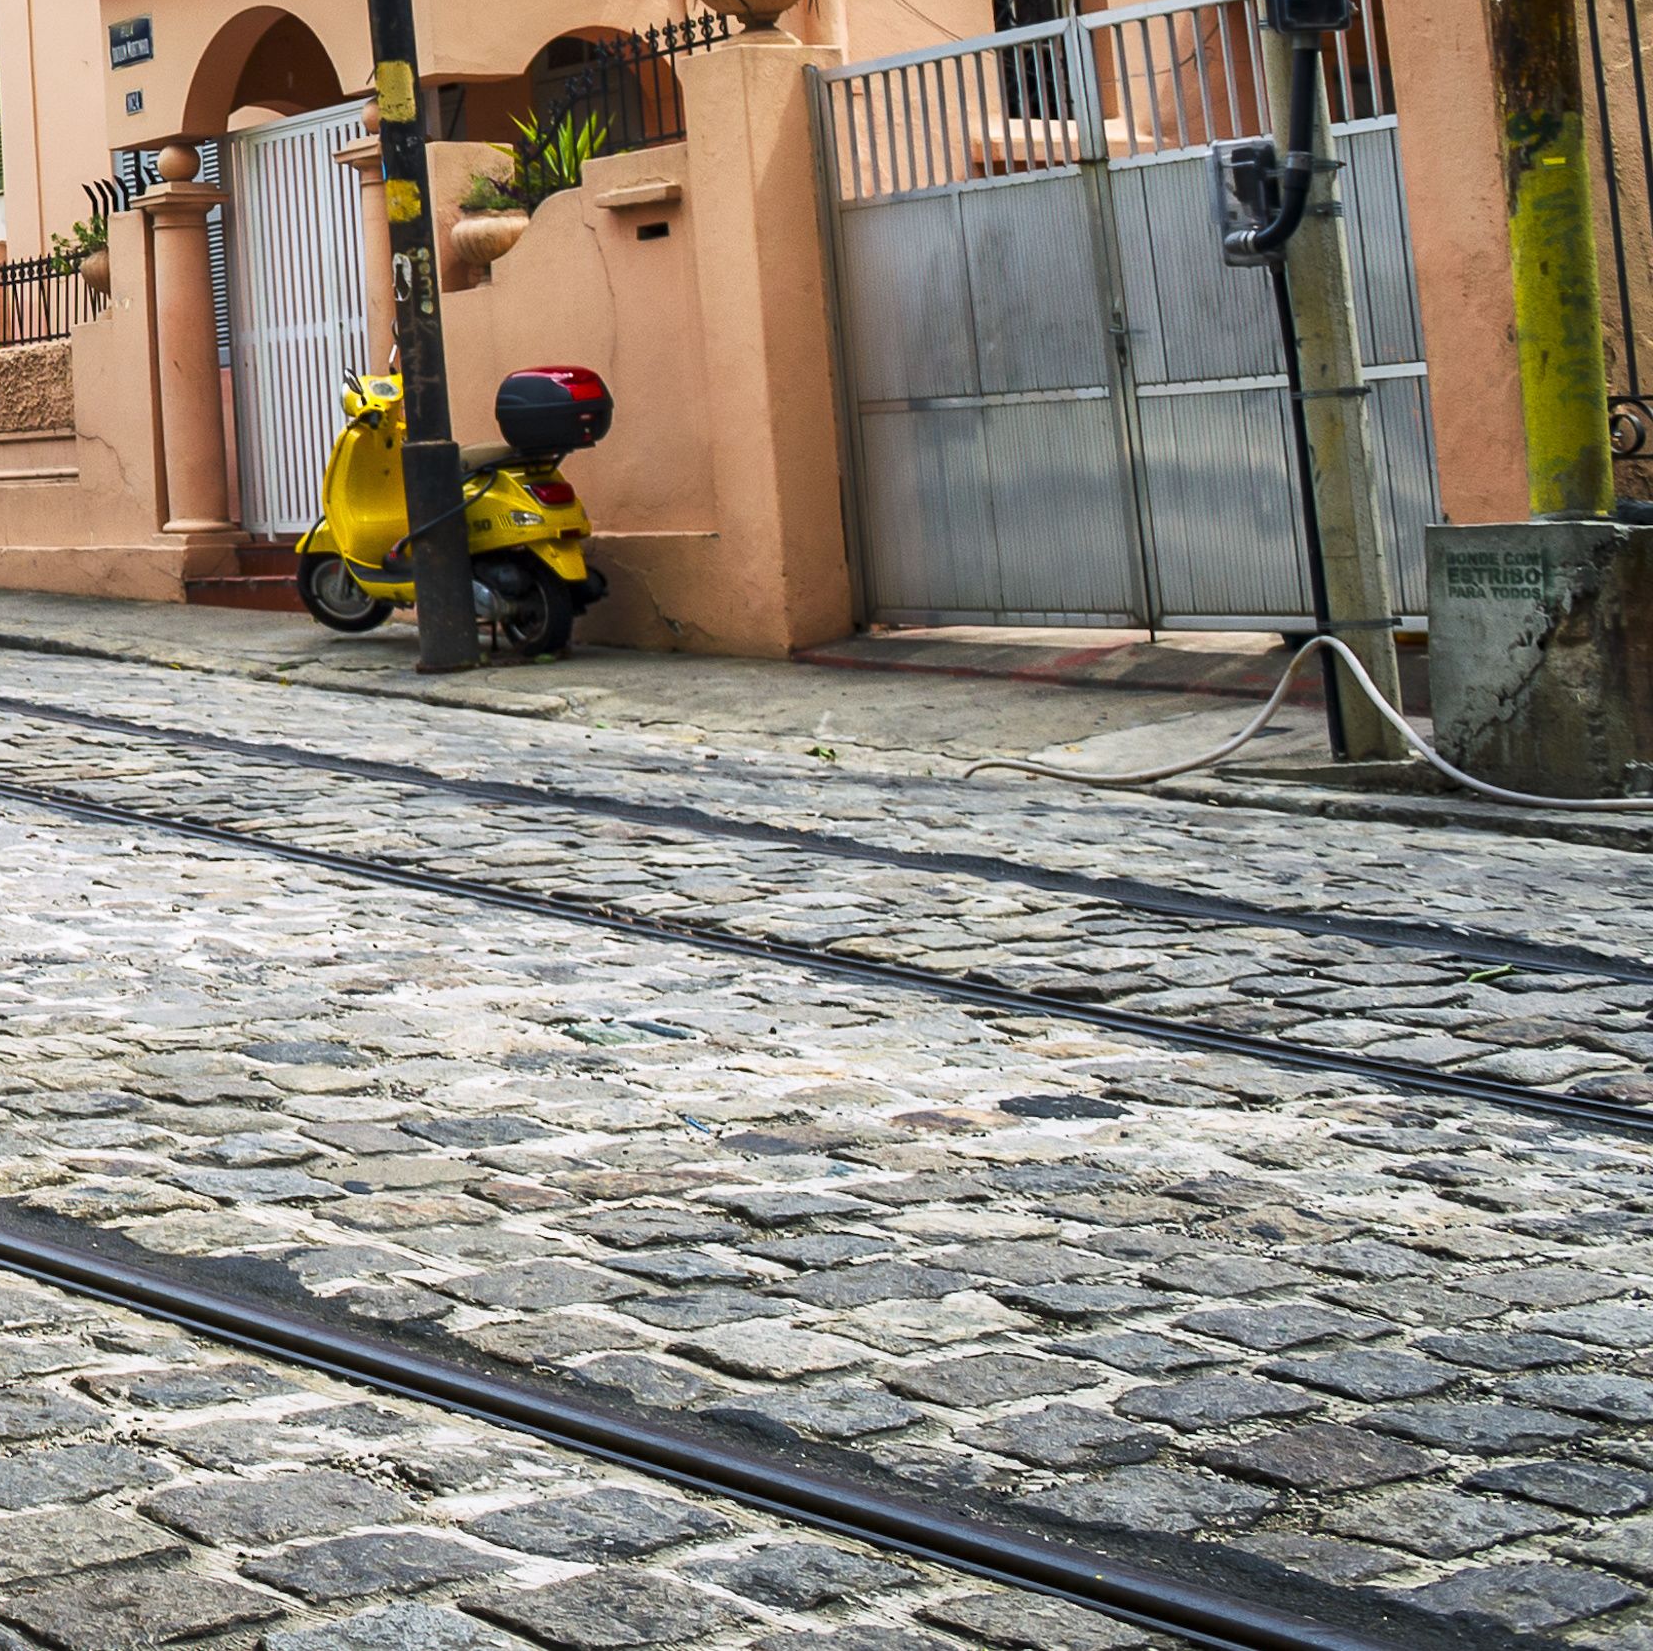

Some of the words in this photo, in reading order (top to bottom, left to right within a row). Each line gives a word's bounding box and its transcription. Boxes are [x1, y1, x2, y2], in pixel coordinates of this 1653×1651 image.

[1447, 567, 1541, 585] ESTRIBO
[1448, 585, 1487, 599] PARA
[1490, 587, 1542, 601] TODOS
